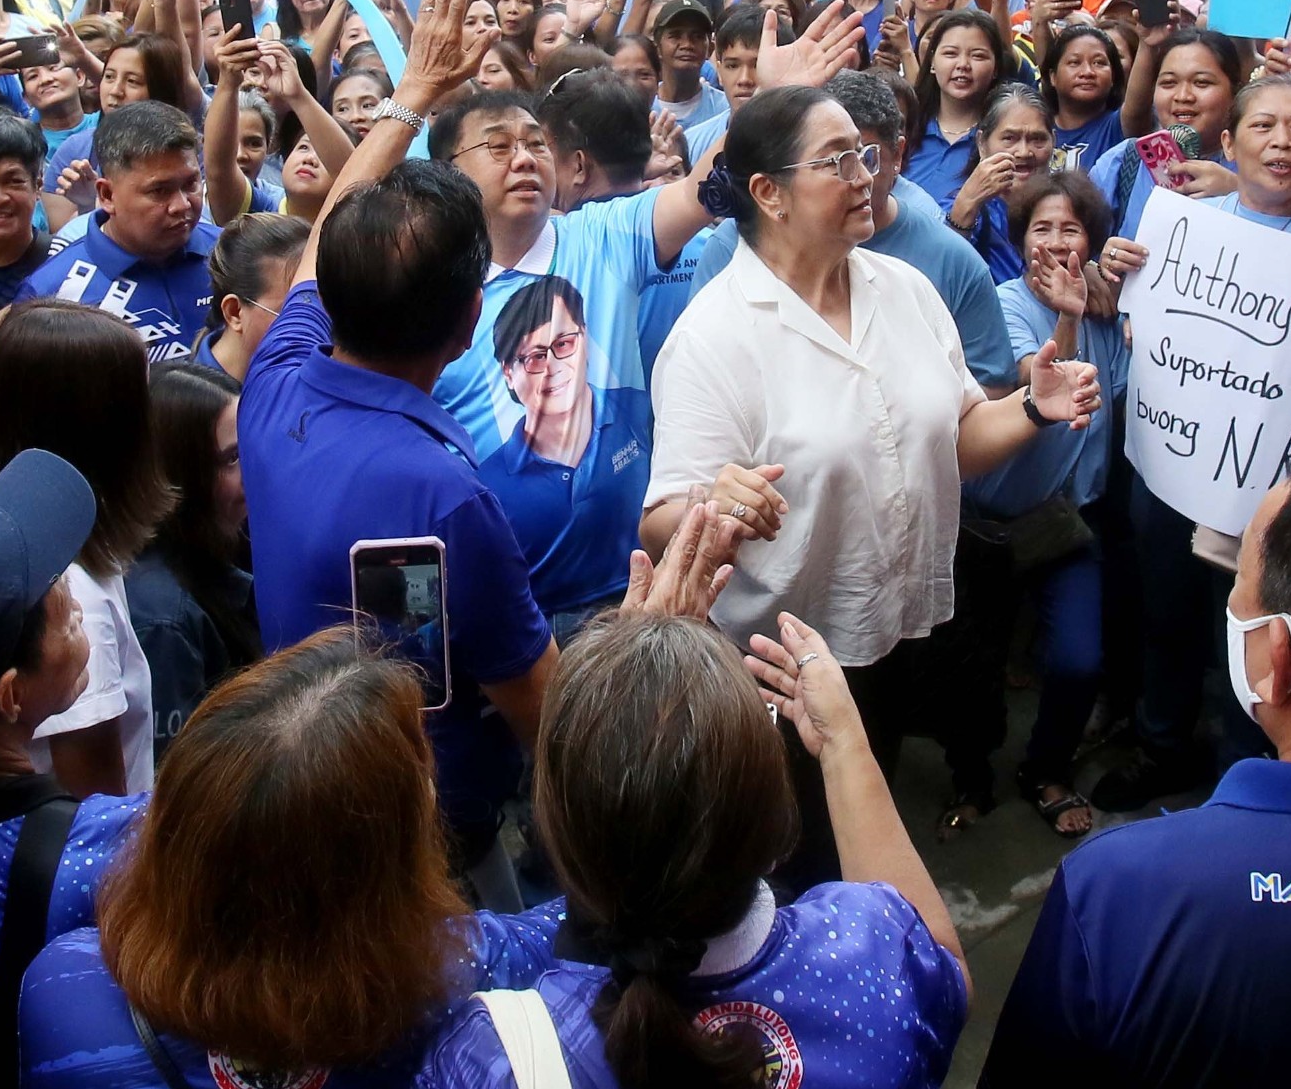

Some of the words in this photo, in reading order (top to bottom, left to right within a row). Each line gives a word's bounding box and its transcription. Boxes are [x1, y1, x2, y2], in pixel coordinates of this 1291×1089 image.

[1150, 337, 1283, 400] Suportado
[1137, 388, 1200, 458] buong
[697, 1002, 800, 1061] MANDALUYONG
